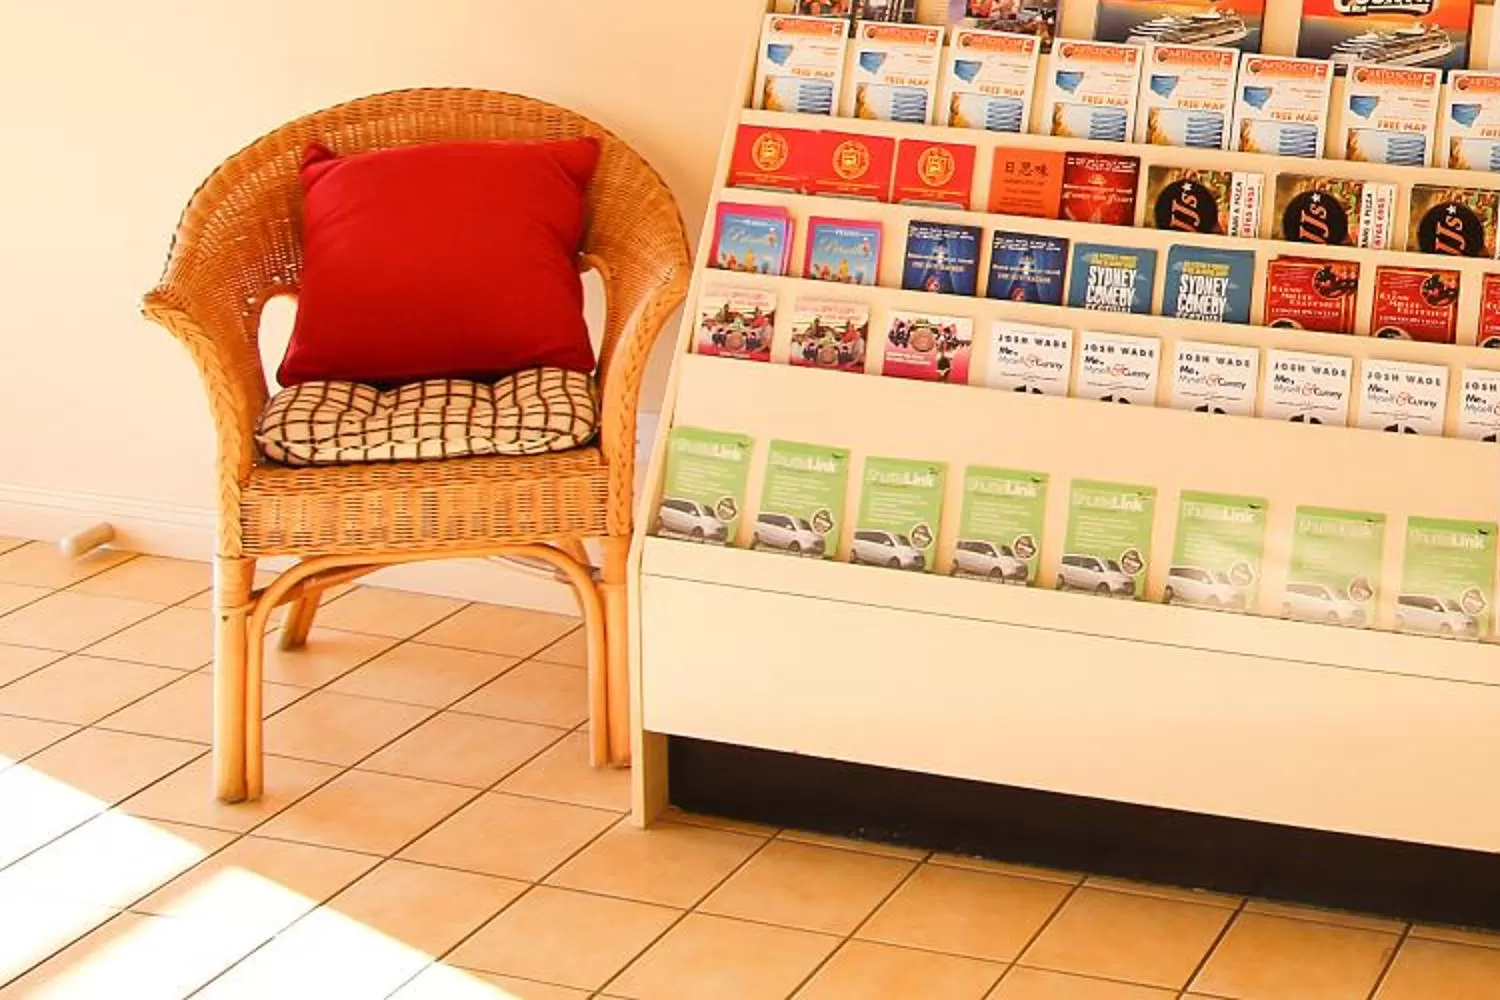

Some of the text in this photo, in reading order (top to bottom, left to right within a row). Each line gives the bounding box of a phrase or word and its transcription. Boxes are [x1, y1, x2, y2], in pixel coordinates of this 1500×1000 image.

[792, 68, 835, 78] FREE MAP
[884, 75, 929, 85] FREE MAP
[979, 85, 1025, 96] FREE MAP
[1081, 95, 1129, 106] FREE MAP
[1177, 100, 1225, 110] FREE MAP
[1270, 111, 1319, 122] FREE MAP
[1377, 119, 1428, 132] FREE MAP
[1233, 181, 1243, 205] PIZZA
[1364, 193, 1373, 217] PIZZA
[1088, 266, 1137, 287] SYDNEY
[1179, 274, 1229, 296] SYDNEY
[1086, 285, 1135, 306] COMEDY
[1177, 293, 1227, 315] COMEDY
[998, 334, 1067, 349] JOSH WADE
[1084, 343, 1154, 358] JOSH WADE
[1179, 354, 1250, 368] JOSH WADE
[1274, 362, 1346, 377] JOSH WADE
[1367, 371, 1441, 387] JOSH WADE
[1465, 381, 1497, 392] JOSH
